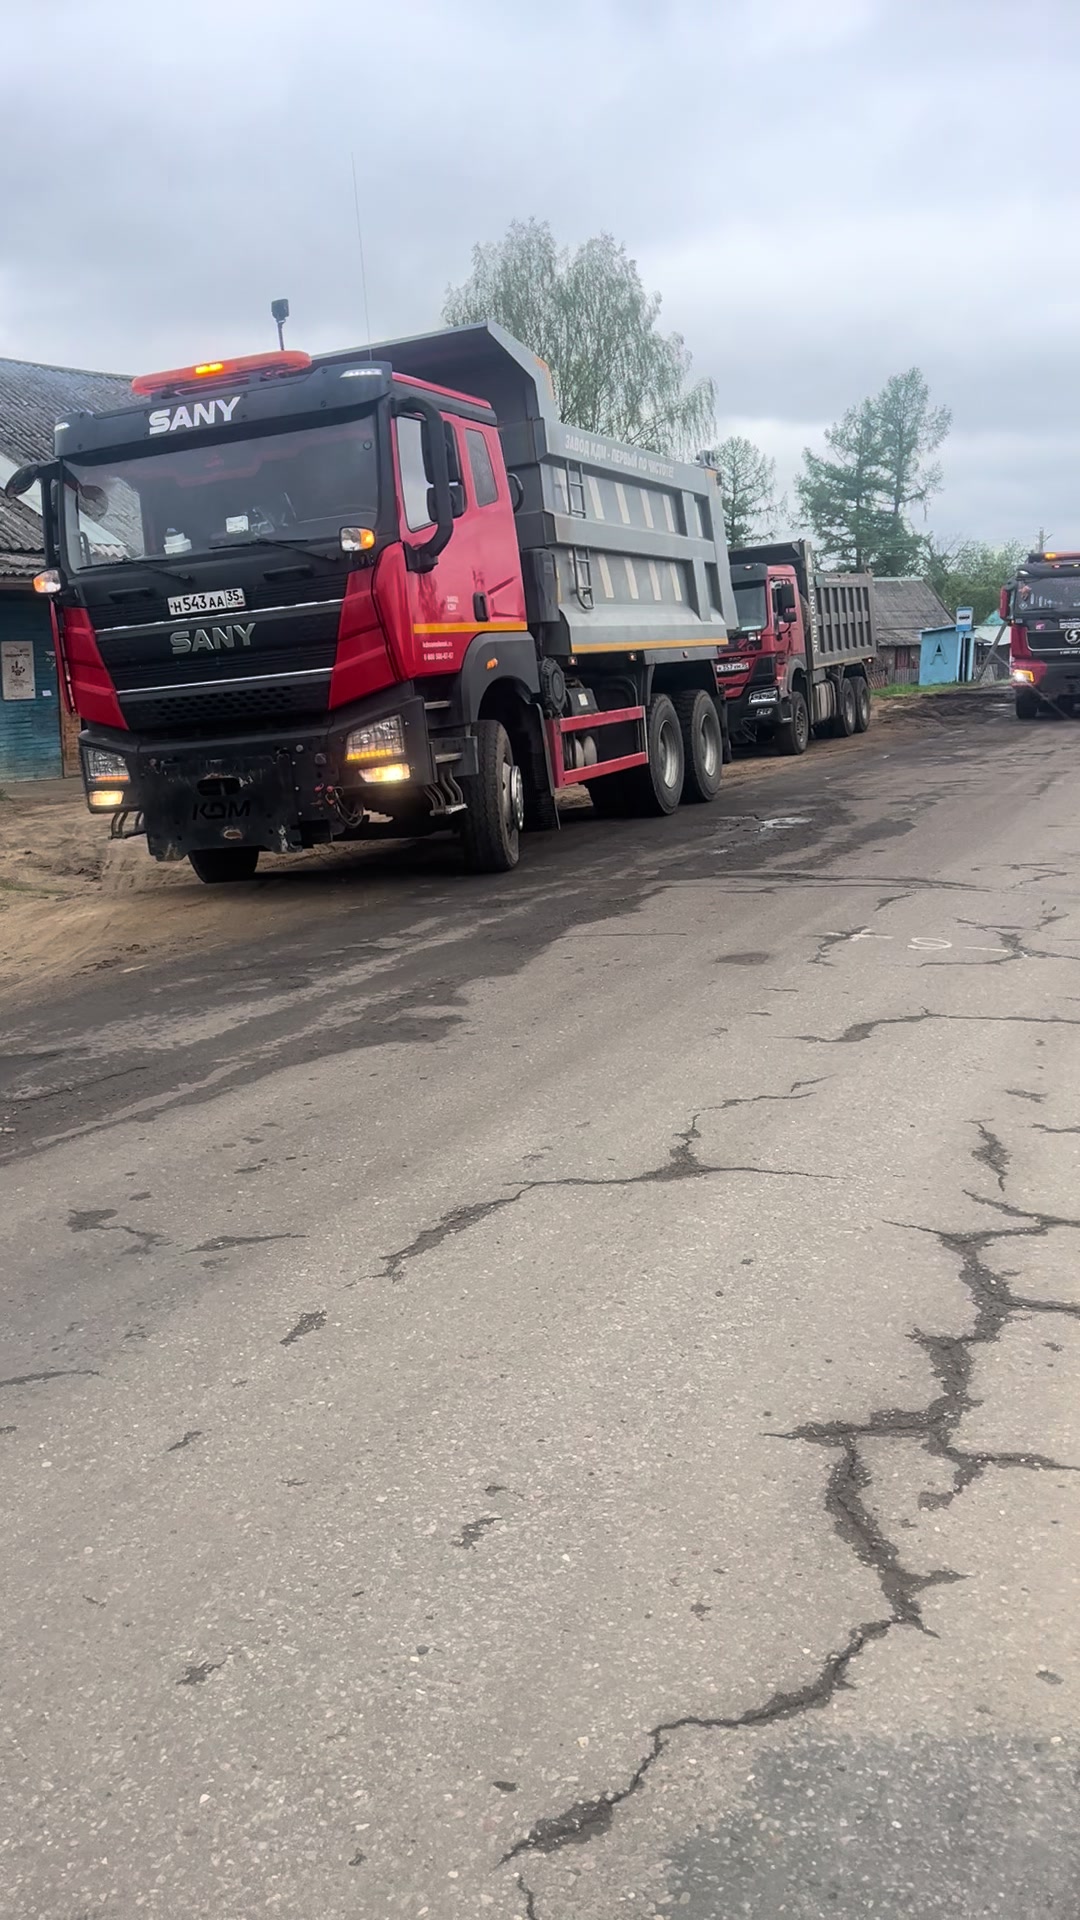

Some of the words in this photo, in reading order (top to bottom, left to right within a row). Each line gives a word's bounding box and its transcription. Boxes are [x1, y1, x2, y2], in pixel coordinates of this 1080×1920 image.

[149, 396, 241, 435] SANY
[565, 434, 590, 458] ЗАВОД
[611, 448, 638, 468] ПЕРВЫЙ
[170, 622, 257, 655] SANY
